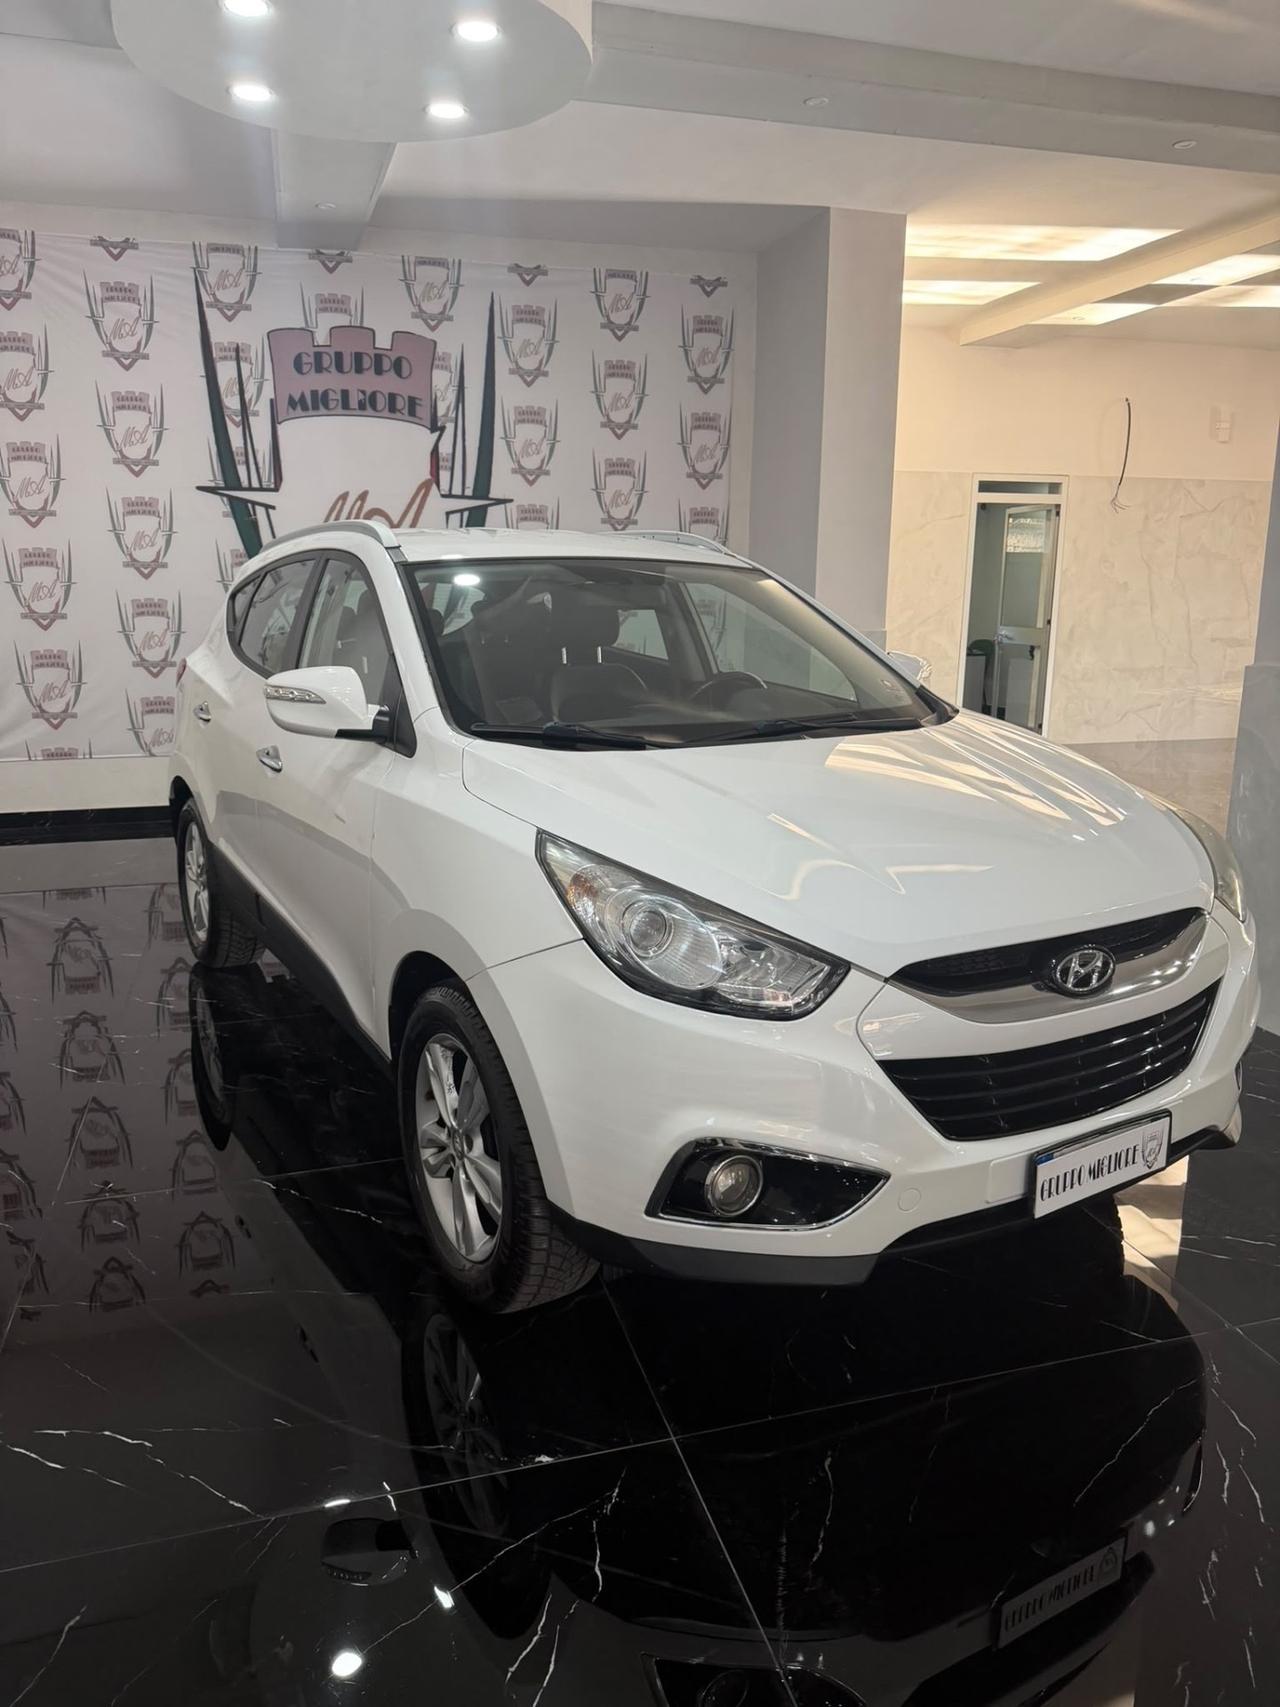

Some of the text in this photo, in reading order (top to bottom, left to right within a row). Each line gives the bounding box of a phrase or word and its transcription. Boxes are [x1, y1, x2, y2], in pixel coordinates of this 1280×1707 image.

[293, 351, 413, 379] GRUPPO
[287, 388, 424, 420] MIGLIORE
[1040, 1144, 1139, 1202] GRUPPO MIGLIORE
